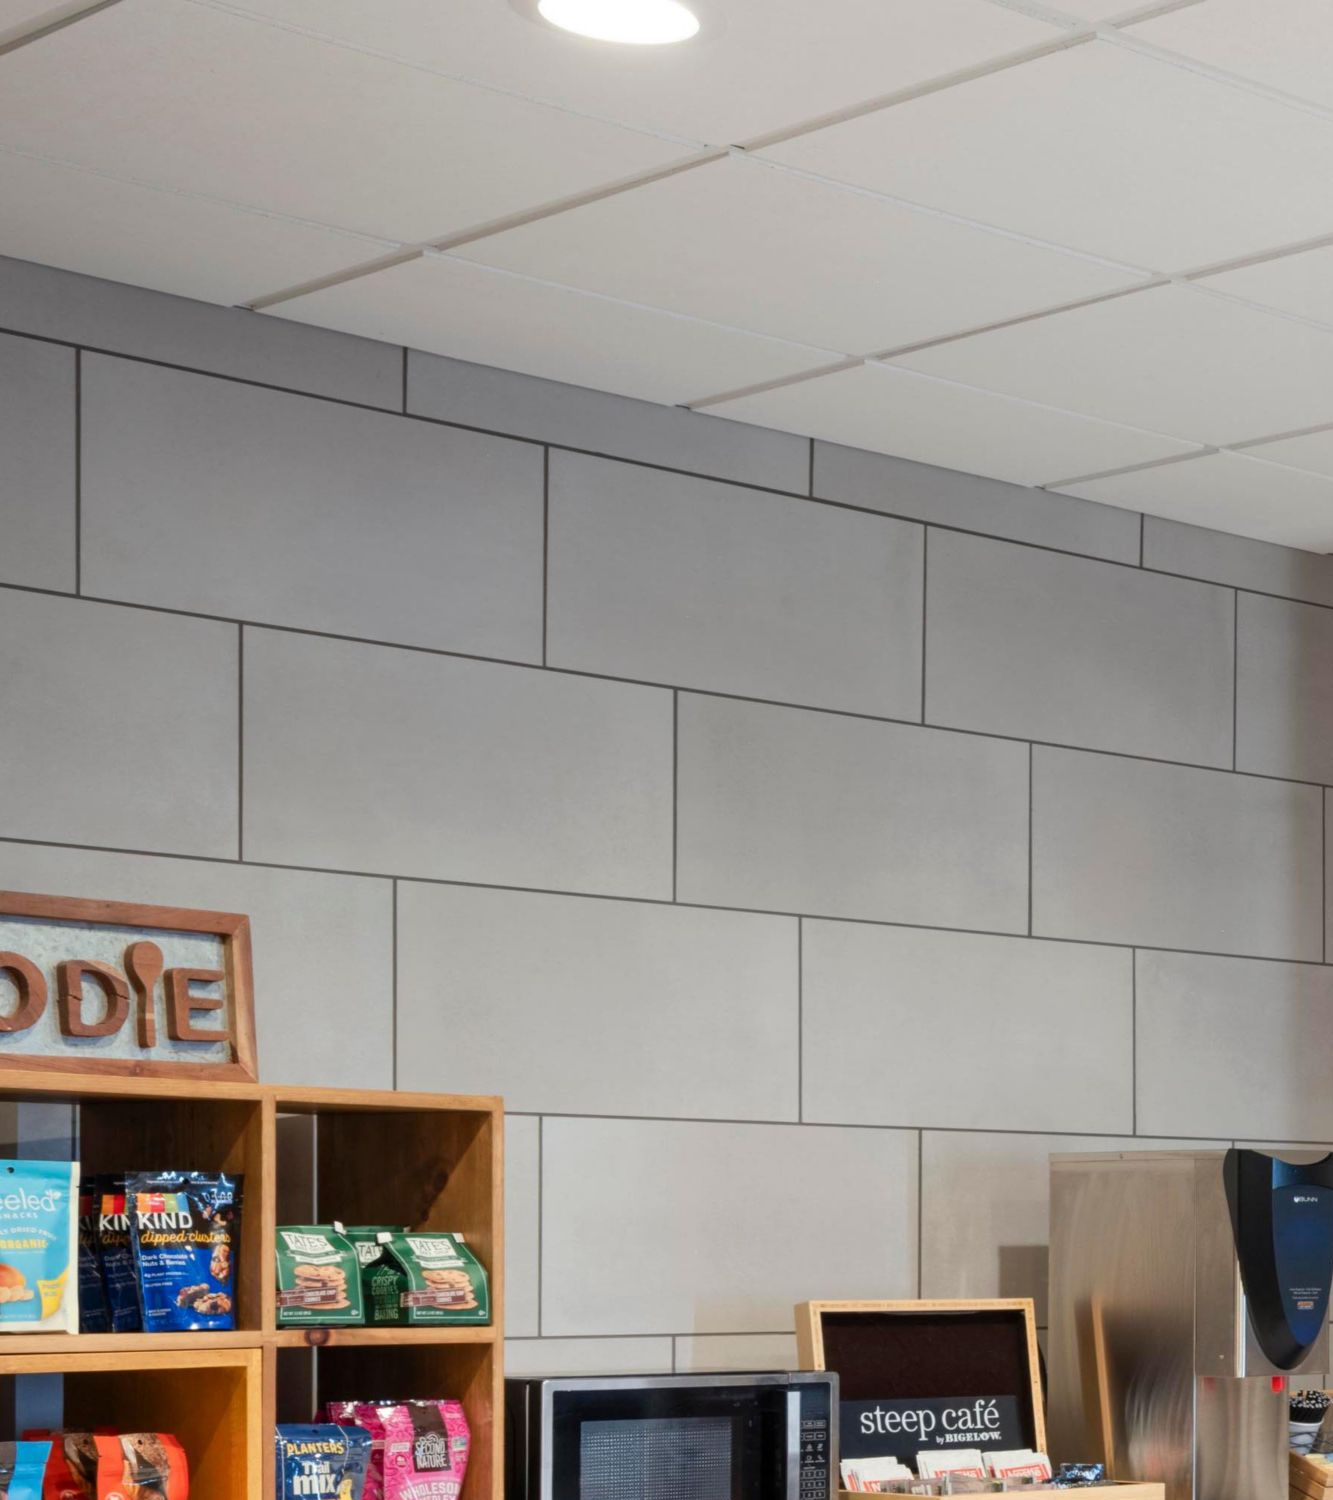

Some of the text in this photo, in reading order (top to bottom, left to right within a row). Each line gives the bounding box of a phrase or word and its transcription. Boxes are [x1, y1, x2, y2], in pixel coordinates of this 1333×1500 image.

[137, 1212, 193, 1229] KIND
[141, 1231, 186, 1247] dipped
[859, 1399, 1001, 1441] steep café
[415, 1438, 446, 1456] SECOND
[936, 1435, 944, 1445] by
[287, 1442, 345, 1456] PLANTERS
[416, 1454, 447, 1469] NATURE
